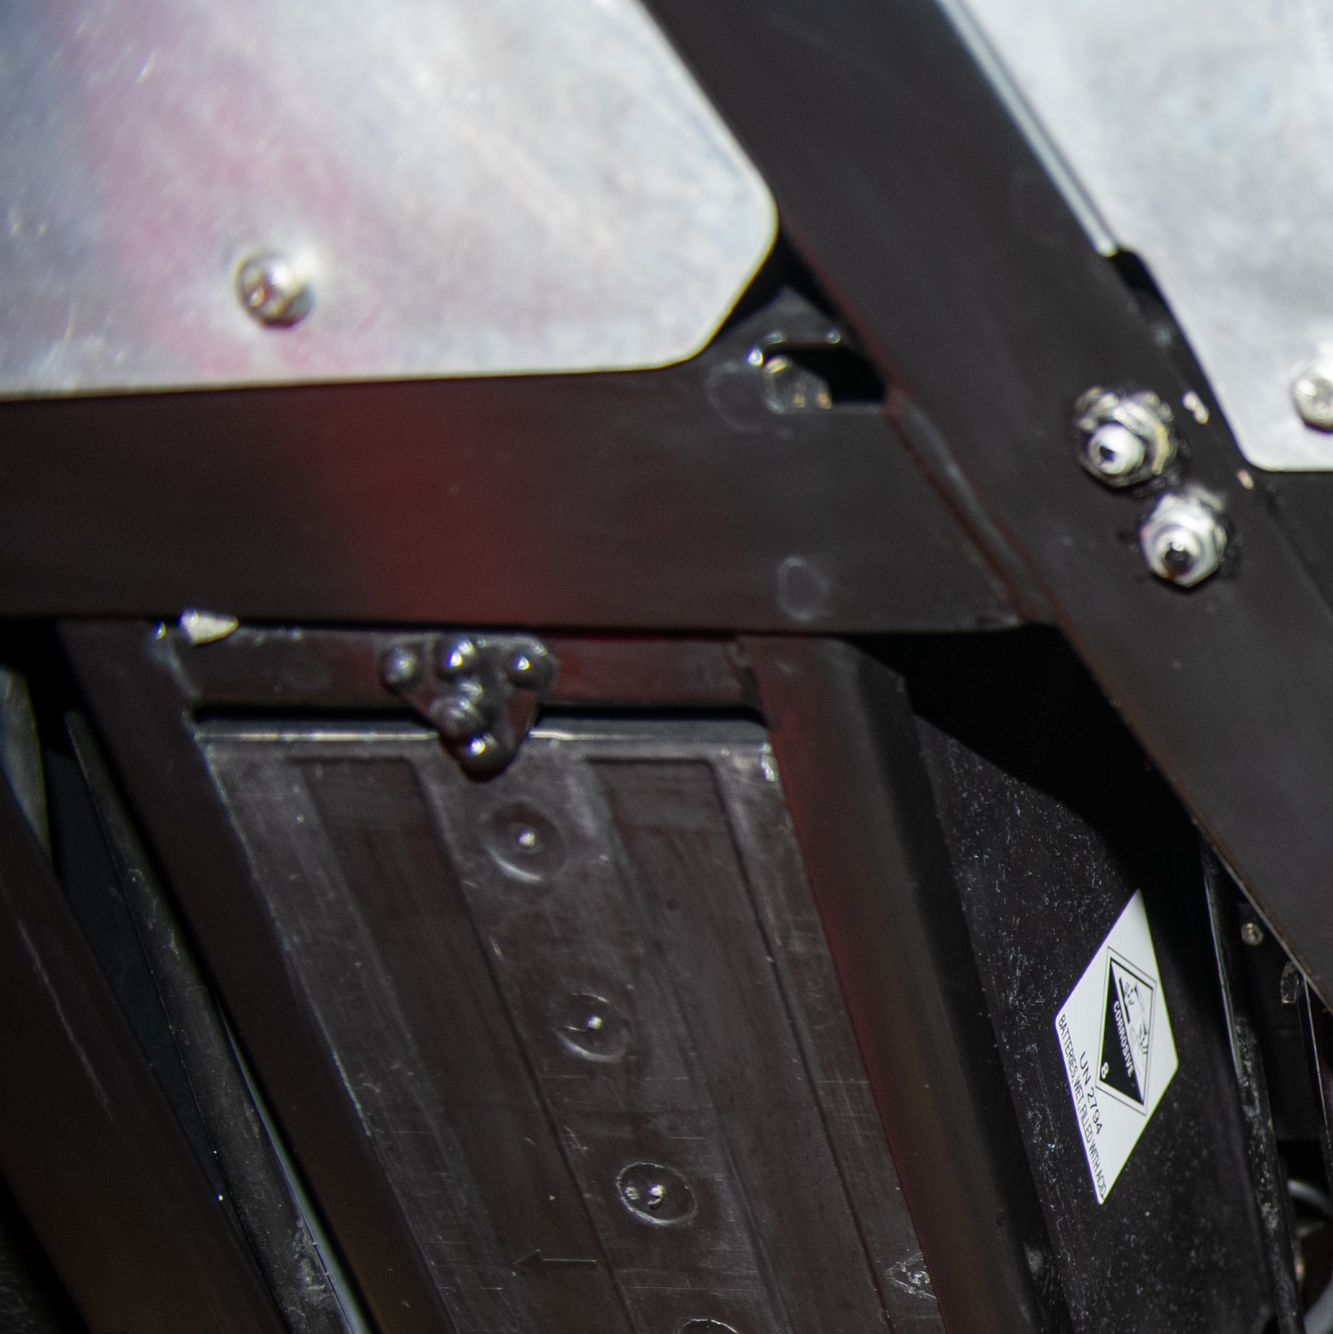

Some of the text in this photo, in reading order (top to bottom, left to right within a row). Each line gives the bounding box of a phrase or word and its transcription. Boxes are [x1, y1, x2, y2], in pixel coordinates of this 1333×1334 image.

[1101, 1062, 1109, 1080] 8
[1113, 1000, 1134, 1078] CORROSIVE
[1080, 1051, 1102, 1134] UN 2794
[1080, 1104, 1093, 1143] FILLED
[1089, 1139, 1100, 1172] WITH
